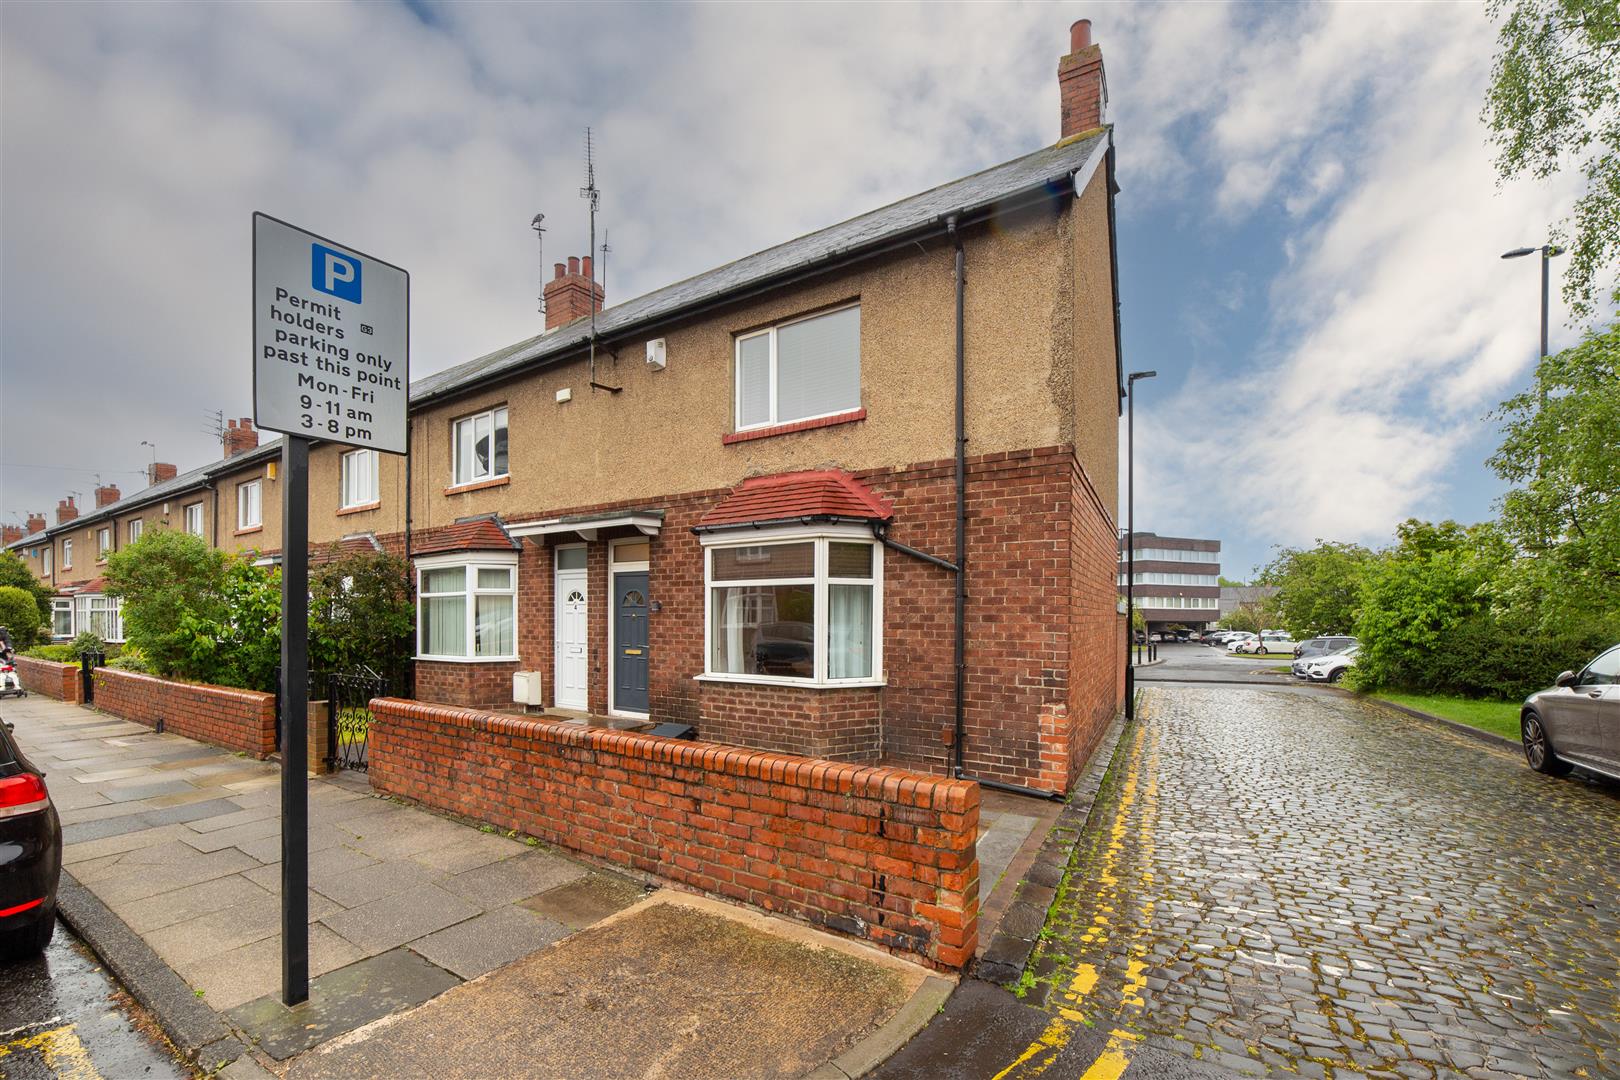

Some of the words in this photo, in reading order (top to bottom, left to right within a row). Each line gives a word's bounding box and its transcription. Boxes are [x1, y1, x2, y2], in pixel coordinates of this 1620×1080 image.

[325, 253, 355, 291] P
[275, 287, 341, 320] Permit
[270, 305, 345, 339] holders
[263, 345, 308, 366] past
[315, 356, 350, 377] this
[357, 370, 400, 390] point
[275, 329, 349, 361] parking
[356, 352, 392, 372] only
[346, 425, 371, 440] pm
[347, 409, 372, 423] am
